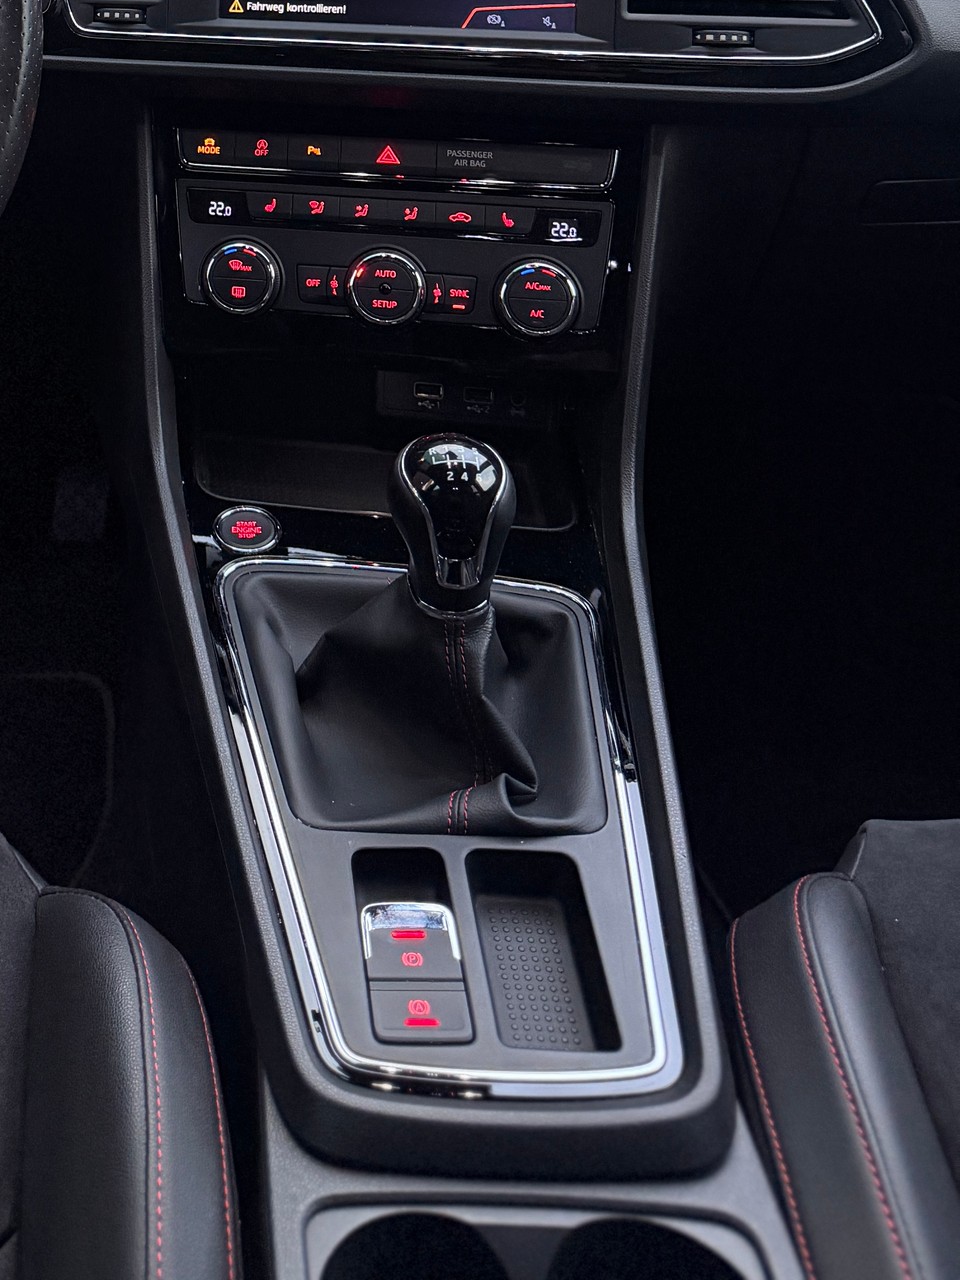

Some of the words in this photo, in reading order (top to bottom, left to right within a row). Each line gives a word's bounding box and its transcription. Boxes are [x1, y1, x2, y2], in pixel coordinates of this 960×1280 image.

[246, 1, 285, 14] Fahrweg
[286, 2, 347, 14] kontrollieren!
[197, 145, 221, 155] MODE
[254, 149, 269, 157] OFF
[446, 149, 493, 159] PASSENGER
[454, 158, 468, 167] AIR
[469, 159, 486, 168] BAG
[208, 200, 232, 217] 22.0
[550, 221, 577, 238] 22.0
[374, 269, 397, 279] AUTO
[305, 278, 321, 288] OFF
[449, 288, 470, 299] SYNC
[372, 299, 398, 309] SETUP
[529, 309, 545, 319] A/C
[446, 471, 455, 482] 2
[461, 472, 470, 482] 4
[231, 526, 262, 534] ENGINE
